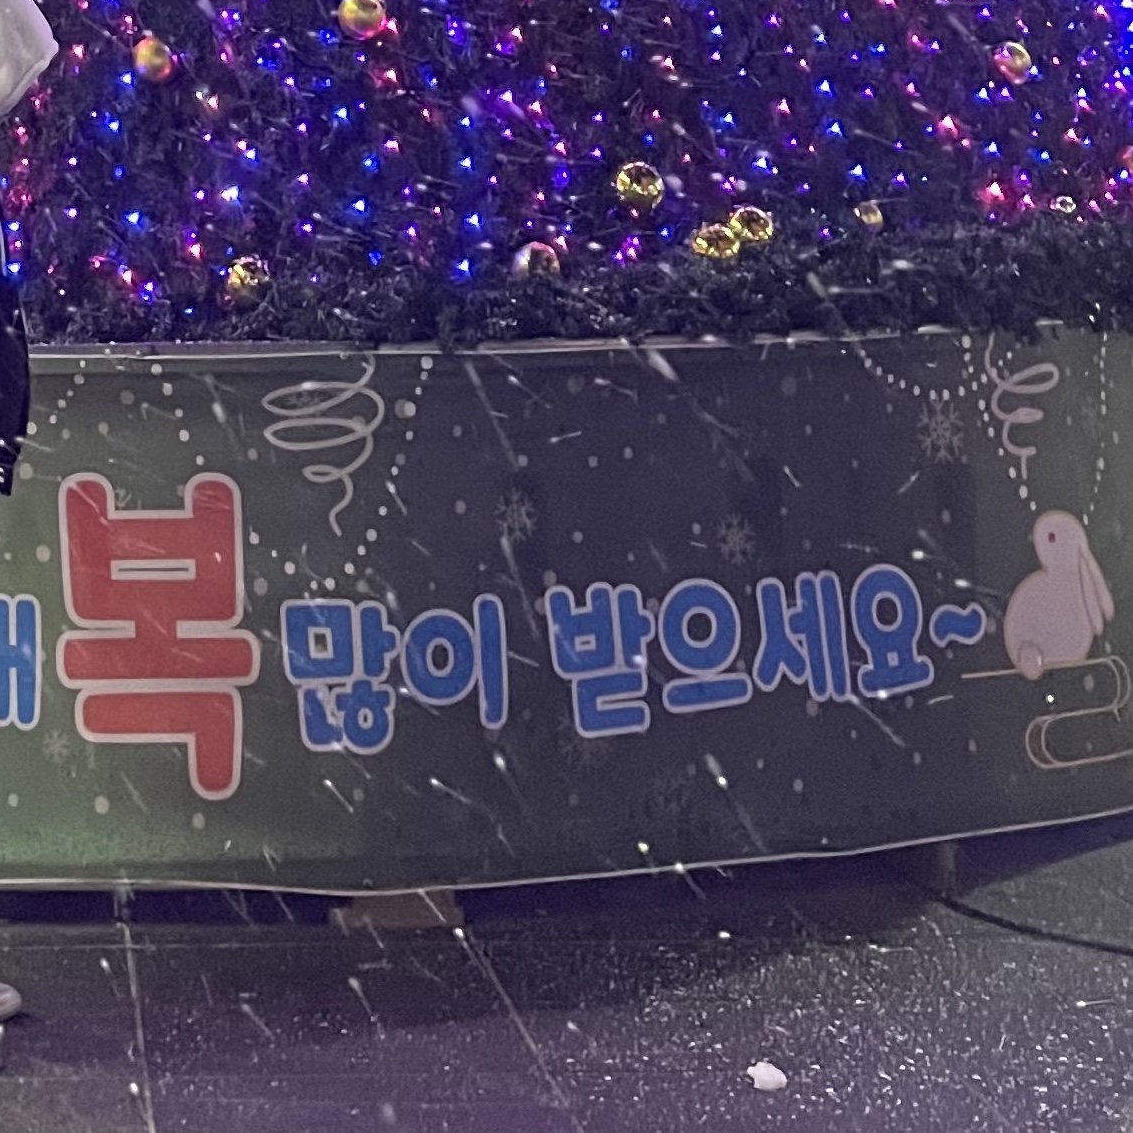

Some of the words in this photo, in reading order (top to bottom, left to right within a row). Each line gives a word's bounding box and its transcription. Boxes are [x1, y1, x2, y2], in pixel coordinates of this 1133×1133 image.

[55, 472, 260, 801] 복
[280, 593, 508, 755] 많이
[545, 564, 986, 738] 받으세요~
